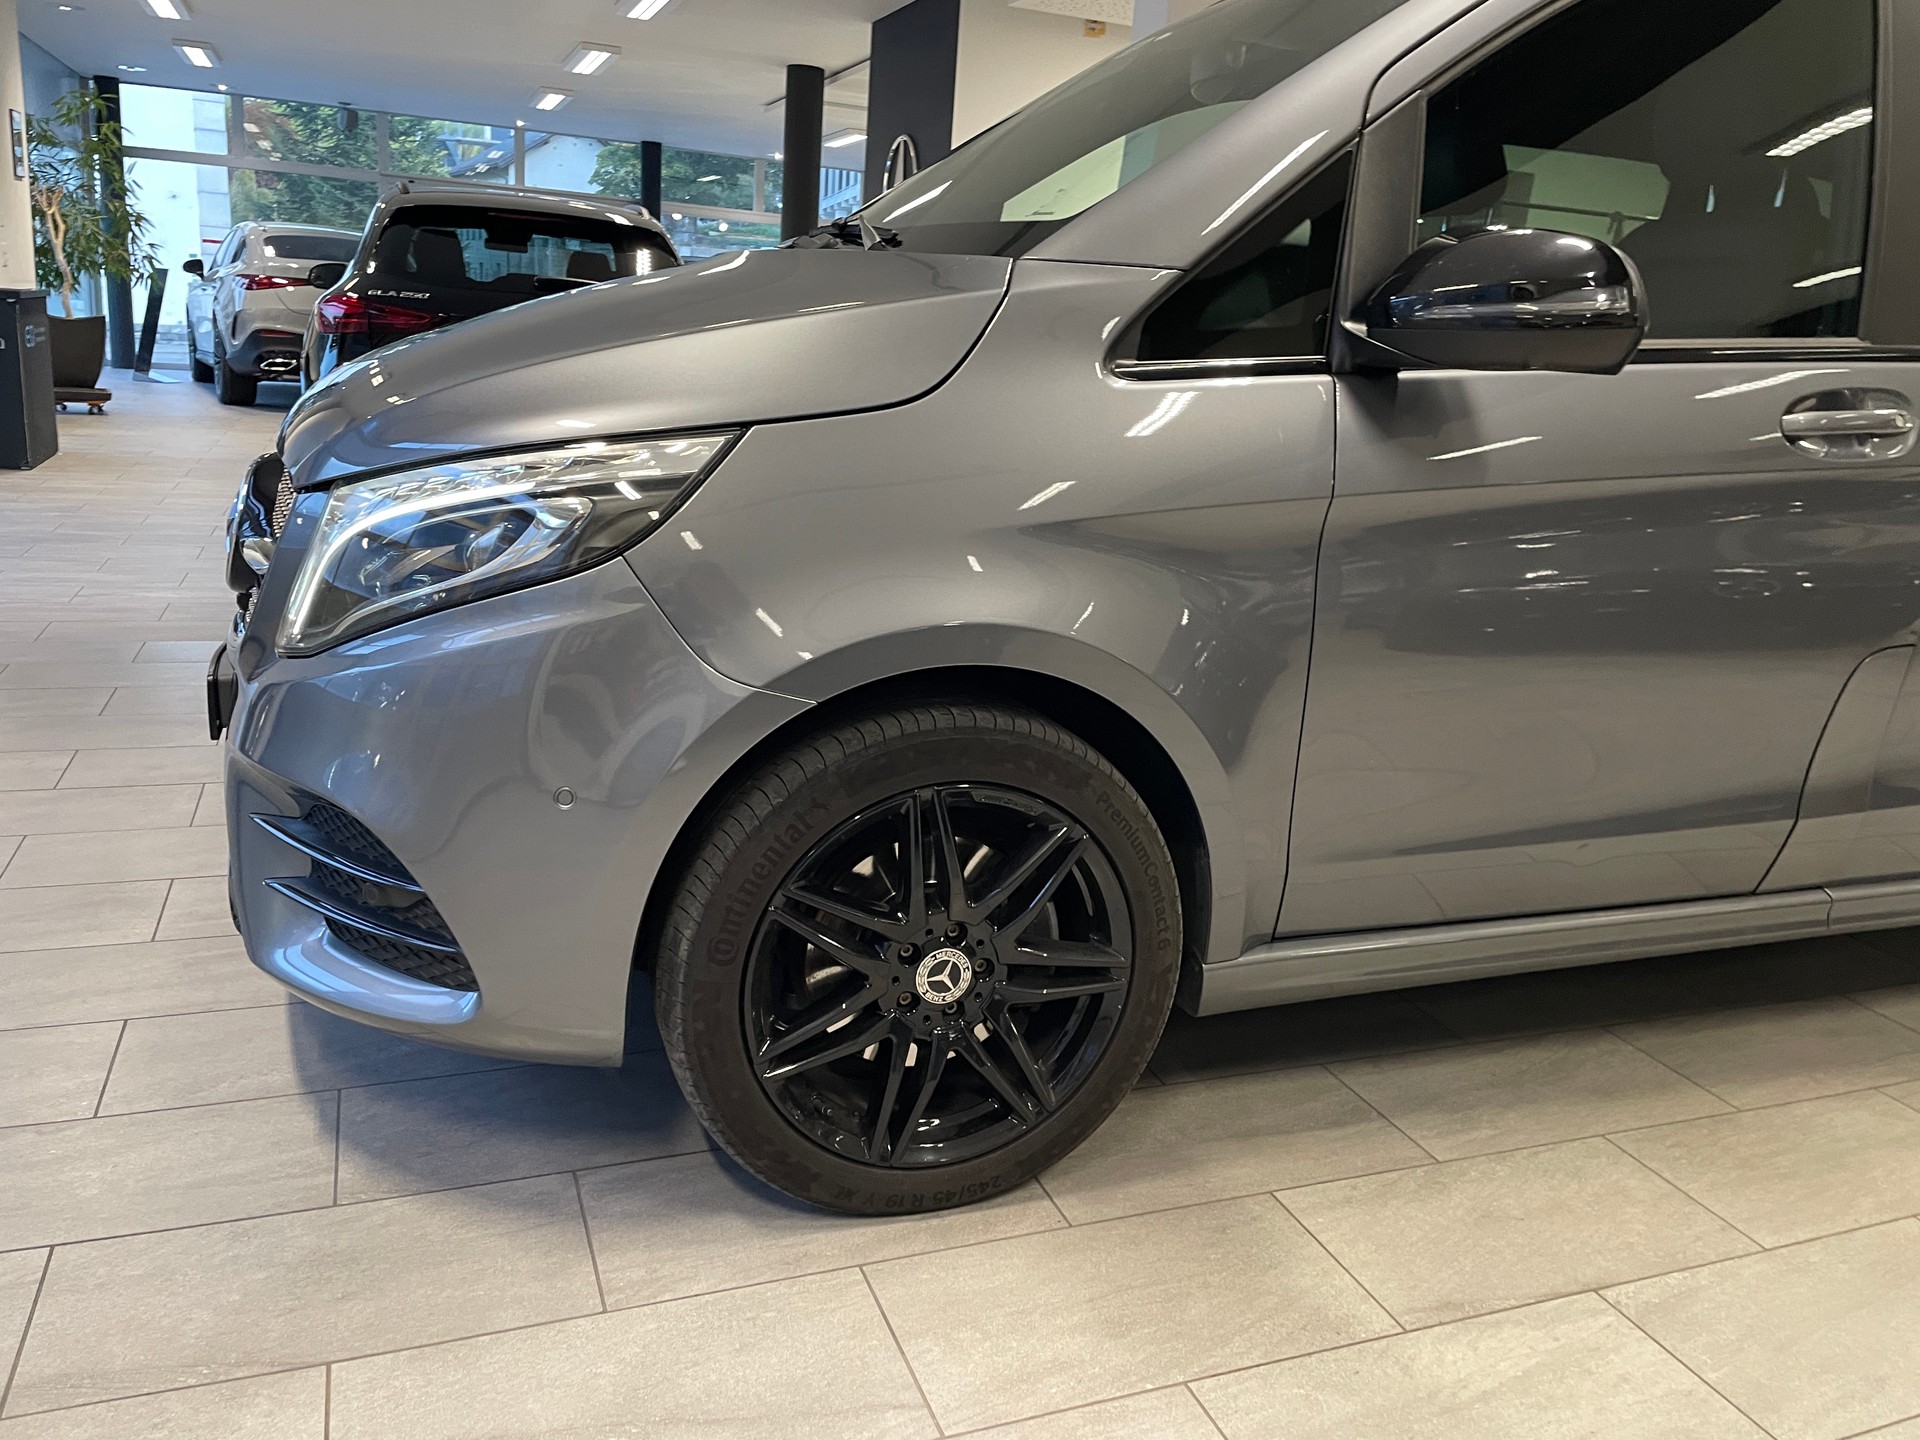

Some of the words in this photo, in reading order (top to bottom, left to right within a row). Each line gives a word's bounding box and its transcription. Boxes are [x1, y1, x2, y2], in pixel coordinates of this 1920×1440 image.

[367, 289, 398, 297] GLA
[399, 291, 431, 299] 250
[1095, 790, 1170, 936] PremiumContact
[707, 811, 815, 967] Continental
[935, 951, 969, 969] MERCEDES
[925, 992, 944, 1002] BENZ
[932, 1175, 1002, 1202] 245/45
[911, 1193, 925, 1207] R
